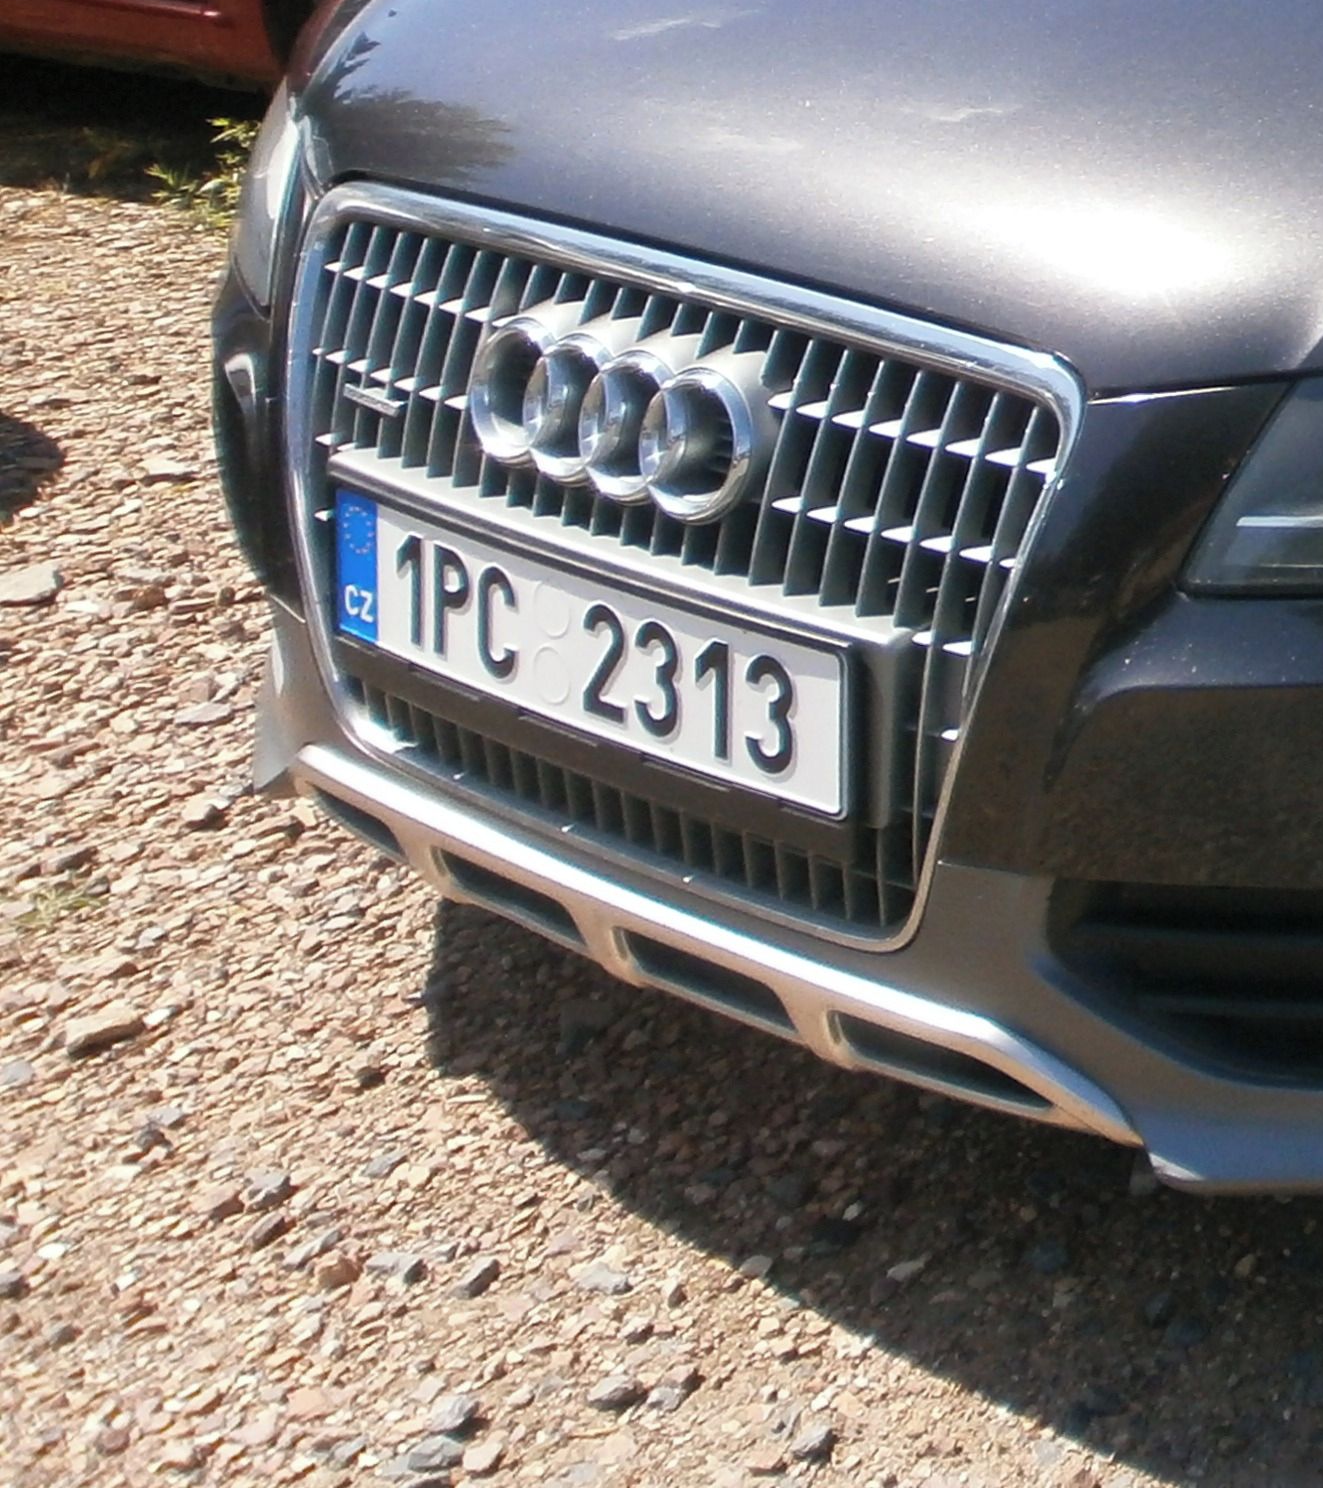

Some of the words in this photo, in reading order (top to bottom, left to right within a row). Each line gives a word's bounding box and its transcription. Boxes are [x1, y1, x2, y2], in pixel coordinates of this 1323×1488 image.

[343, 583, 375, 624] CZ
[395, 531, 519, 680] 1PC
[581, 600, 799, 777] 2313
